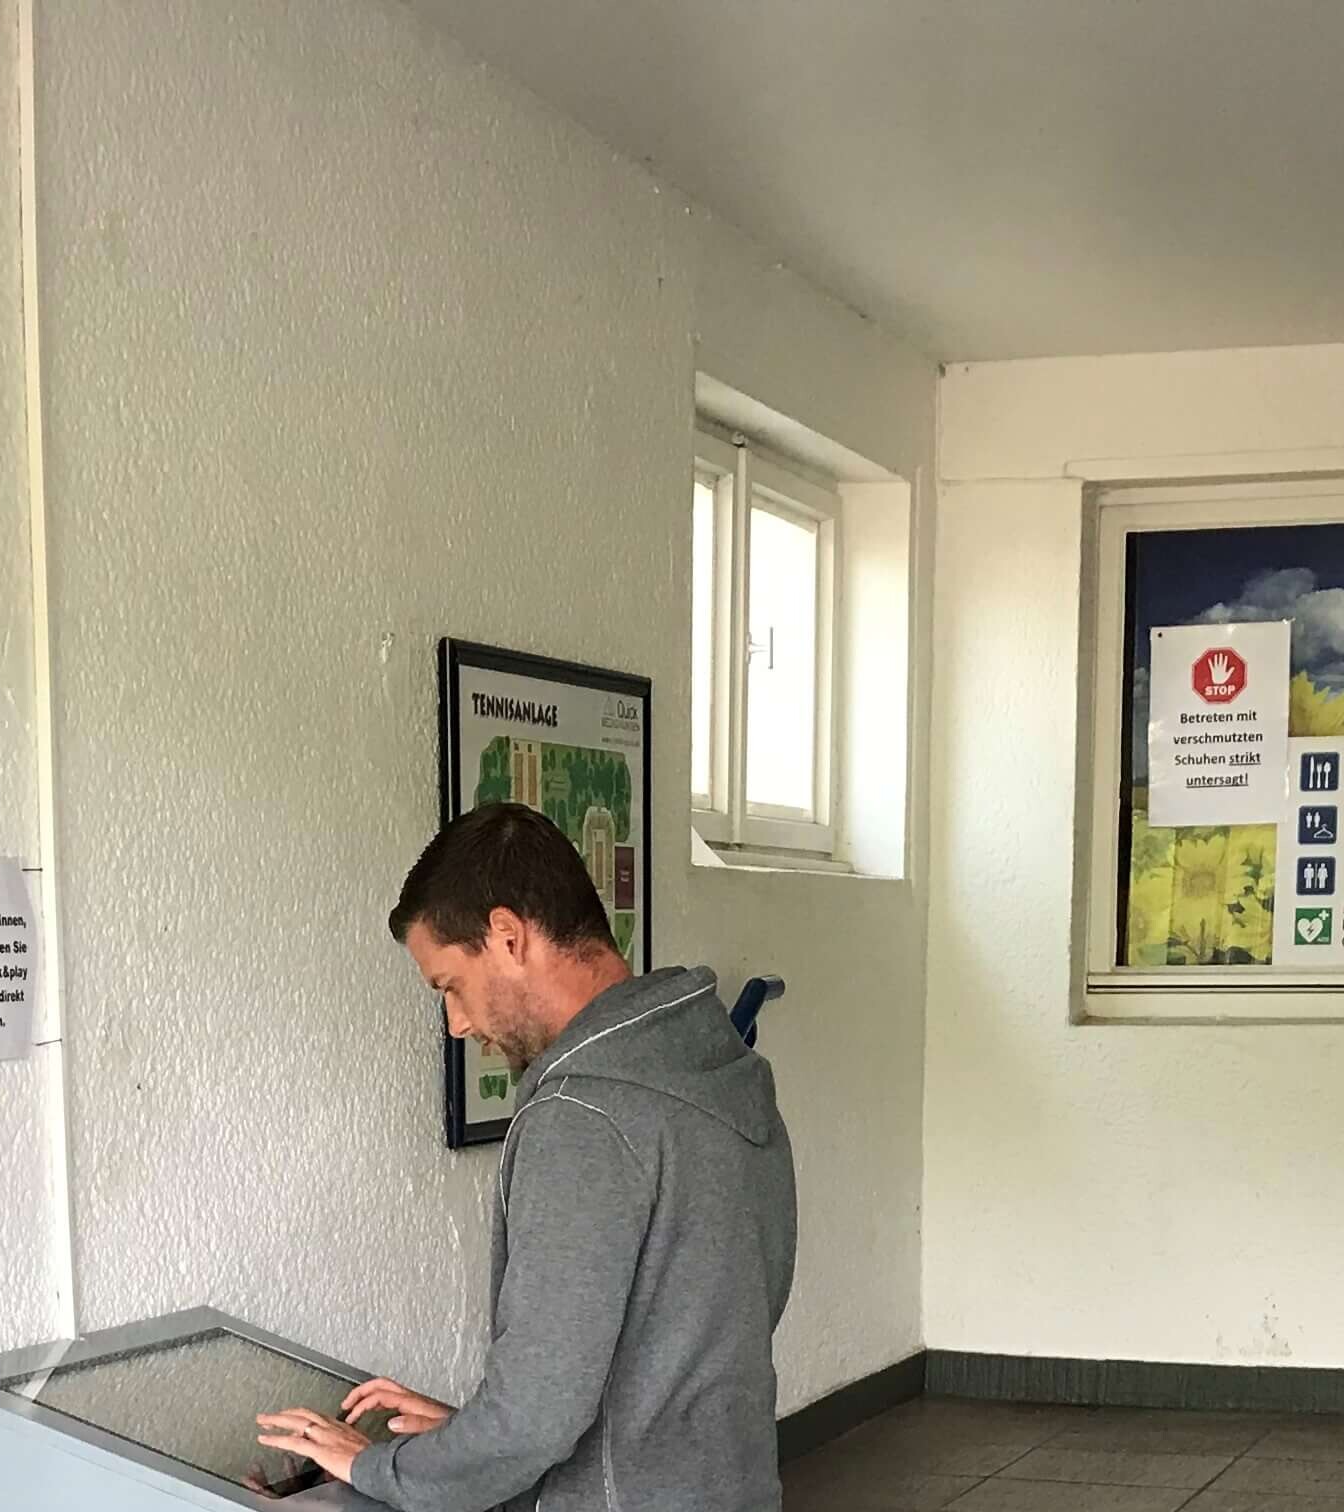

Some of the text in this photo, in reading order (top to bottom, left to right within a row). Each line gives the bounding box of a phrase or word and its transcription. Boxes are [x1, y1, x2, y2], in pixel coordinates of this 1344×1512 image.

[1205, 685, 1235, 696] STOP
[471, 693, 558, 728] TENNISANLAGE
[1180, 710, 1257, 724] Betreten mit
[1173, 732, 1263, 745] verschmutzten
[1174, 752, 1261, 766] Schuhen strikt
[1186, 773, 1248, 787] untersagt!
[13, 941, 27, 953] Sie
